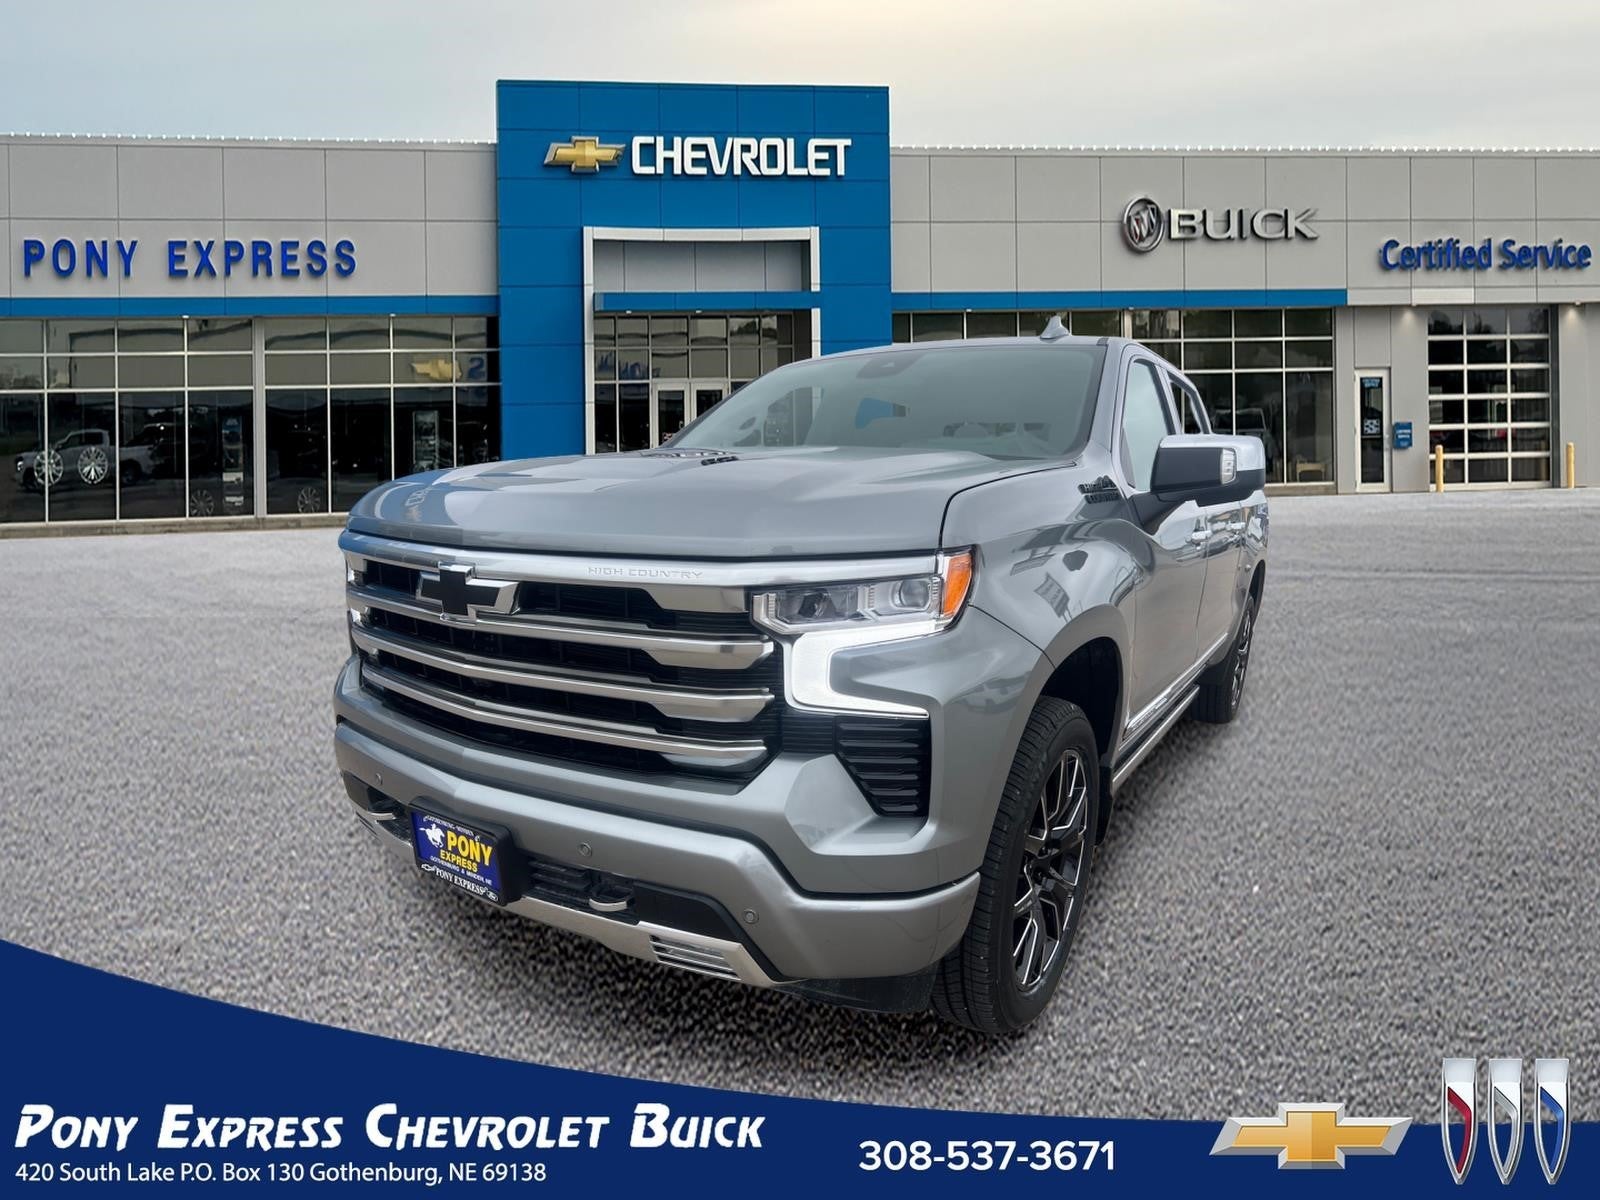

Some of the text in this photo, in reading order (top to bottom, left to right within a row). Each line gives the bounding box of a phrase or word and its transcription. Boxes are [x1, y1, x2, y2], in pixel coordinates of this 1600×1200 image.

[631, 136, 852, 177] CHEVROLET
[1168, 207, 1320, 241] BUICK
[23, 239, 357, 278] PONY EXPRESS
[1380, 238, 1592, 271] Certified Service
[588, 567, 703, 579] HIGH COUNTRY
[440, 850, 478, 873] EXPRESS
[446, 830, 492, 866] PONY
[436, 867, 485, 896] PONY EXPRESS
